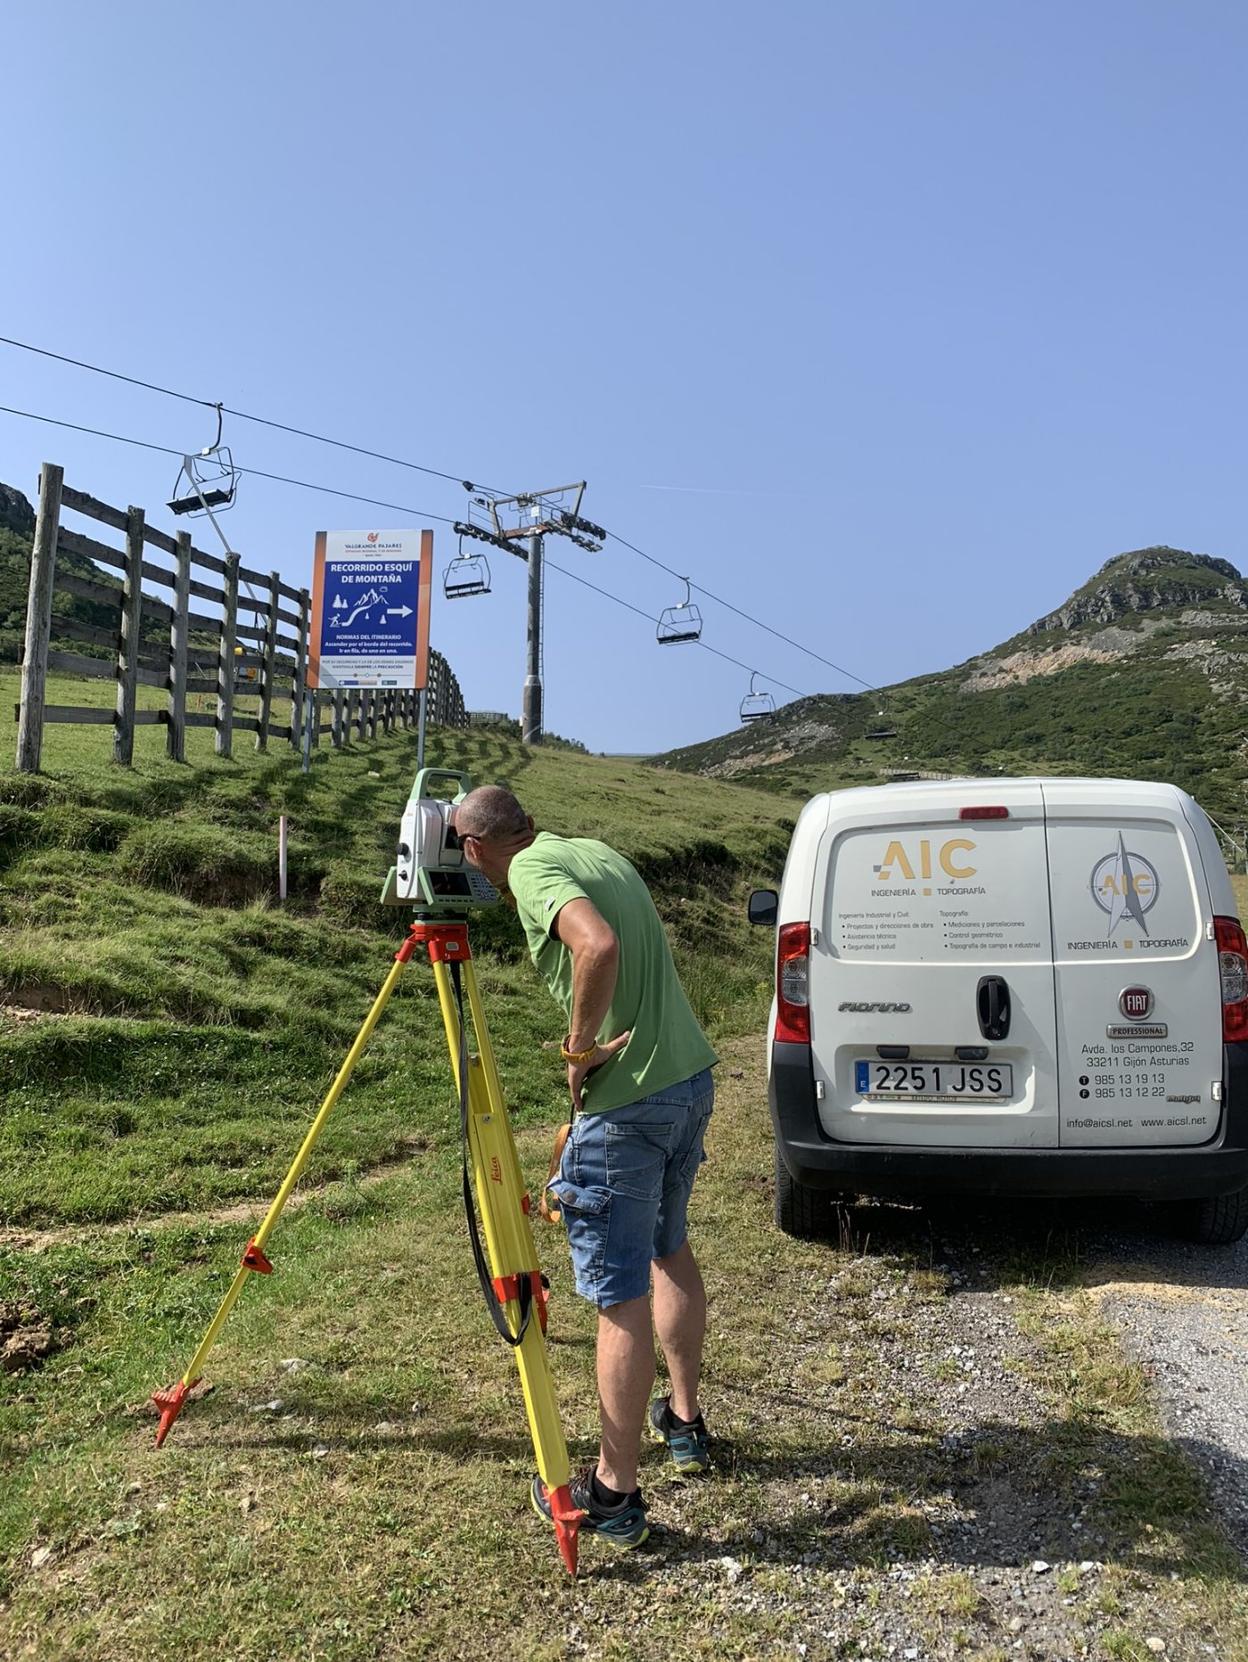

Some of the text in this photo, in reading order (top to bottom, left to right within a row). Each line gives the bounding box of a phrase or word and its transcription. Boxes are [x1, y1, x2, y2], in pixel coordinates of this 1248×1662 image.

[384, 562, 412, 572] ESQUÍ
[355, 574, 402, 583] MONTAÑA
[874, 839, 977, 880] AIC
[1099, 874, 1152, 896] AIC
[872, 886, 986, 897] INGENIERÍA TOPOGRAFÍA
[1067, 938, 1189, 950] INGENIERÍA TOPOGRAFÍA
[1126, 995, 1147, 1011] FIAT
[1112, 1027, 1163, 1035] PROFESSIONAL
[1082, 1044, 1108, 1054] Avda.
[1111, 1044, 1125, 1054] los
[1086, 1056, 1189, 1068] 33211 Gijón Asturias
[876, 1066, 1002, 1092] 2251 JSS
[1095, 1075, 1115, 1085] 985
[1119, 1074, 1132, 1084] 13
[1136, 1074, 1148, 1084] 19
[1152, 1073, 1165, 1083] 13
[1095, 1088, 1115, 1098] 985
[1120, 1088, 1132, 1097] 13
[1136, 1088, 1148, 1097] 12
[1152, 1087, 1165, 1096] 22
[1066, 1116, 1206, 1128] info@aicsl.net www.aicsl.net
[491, 1156, 503, 1185] Leica
